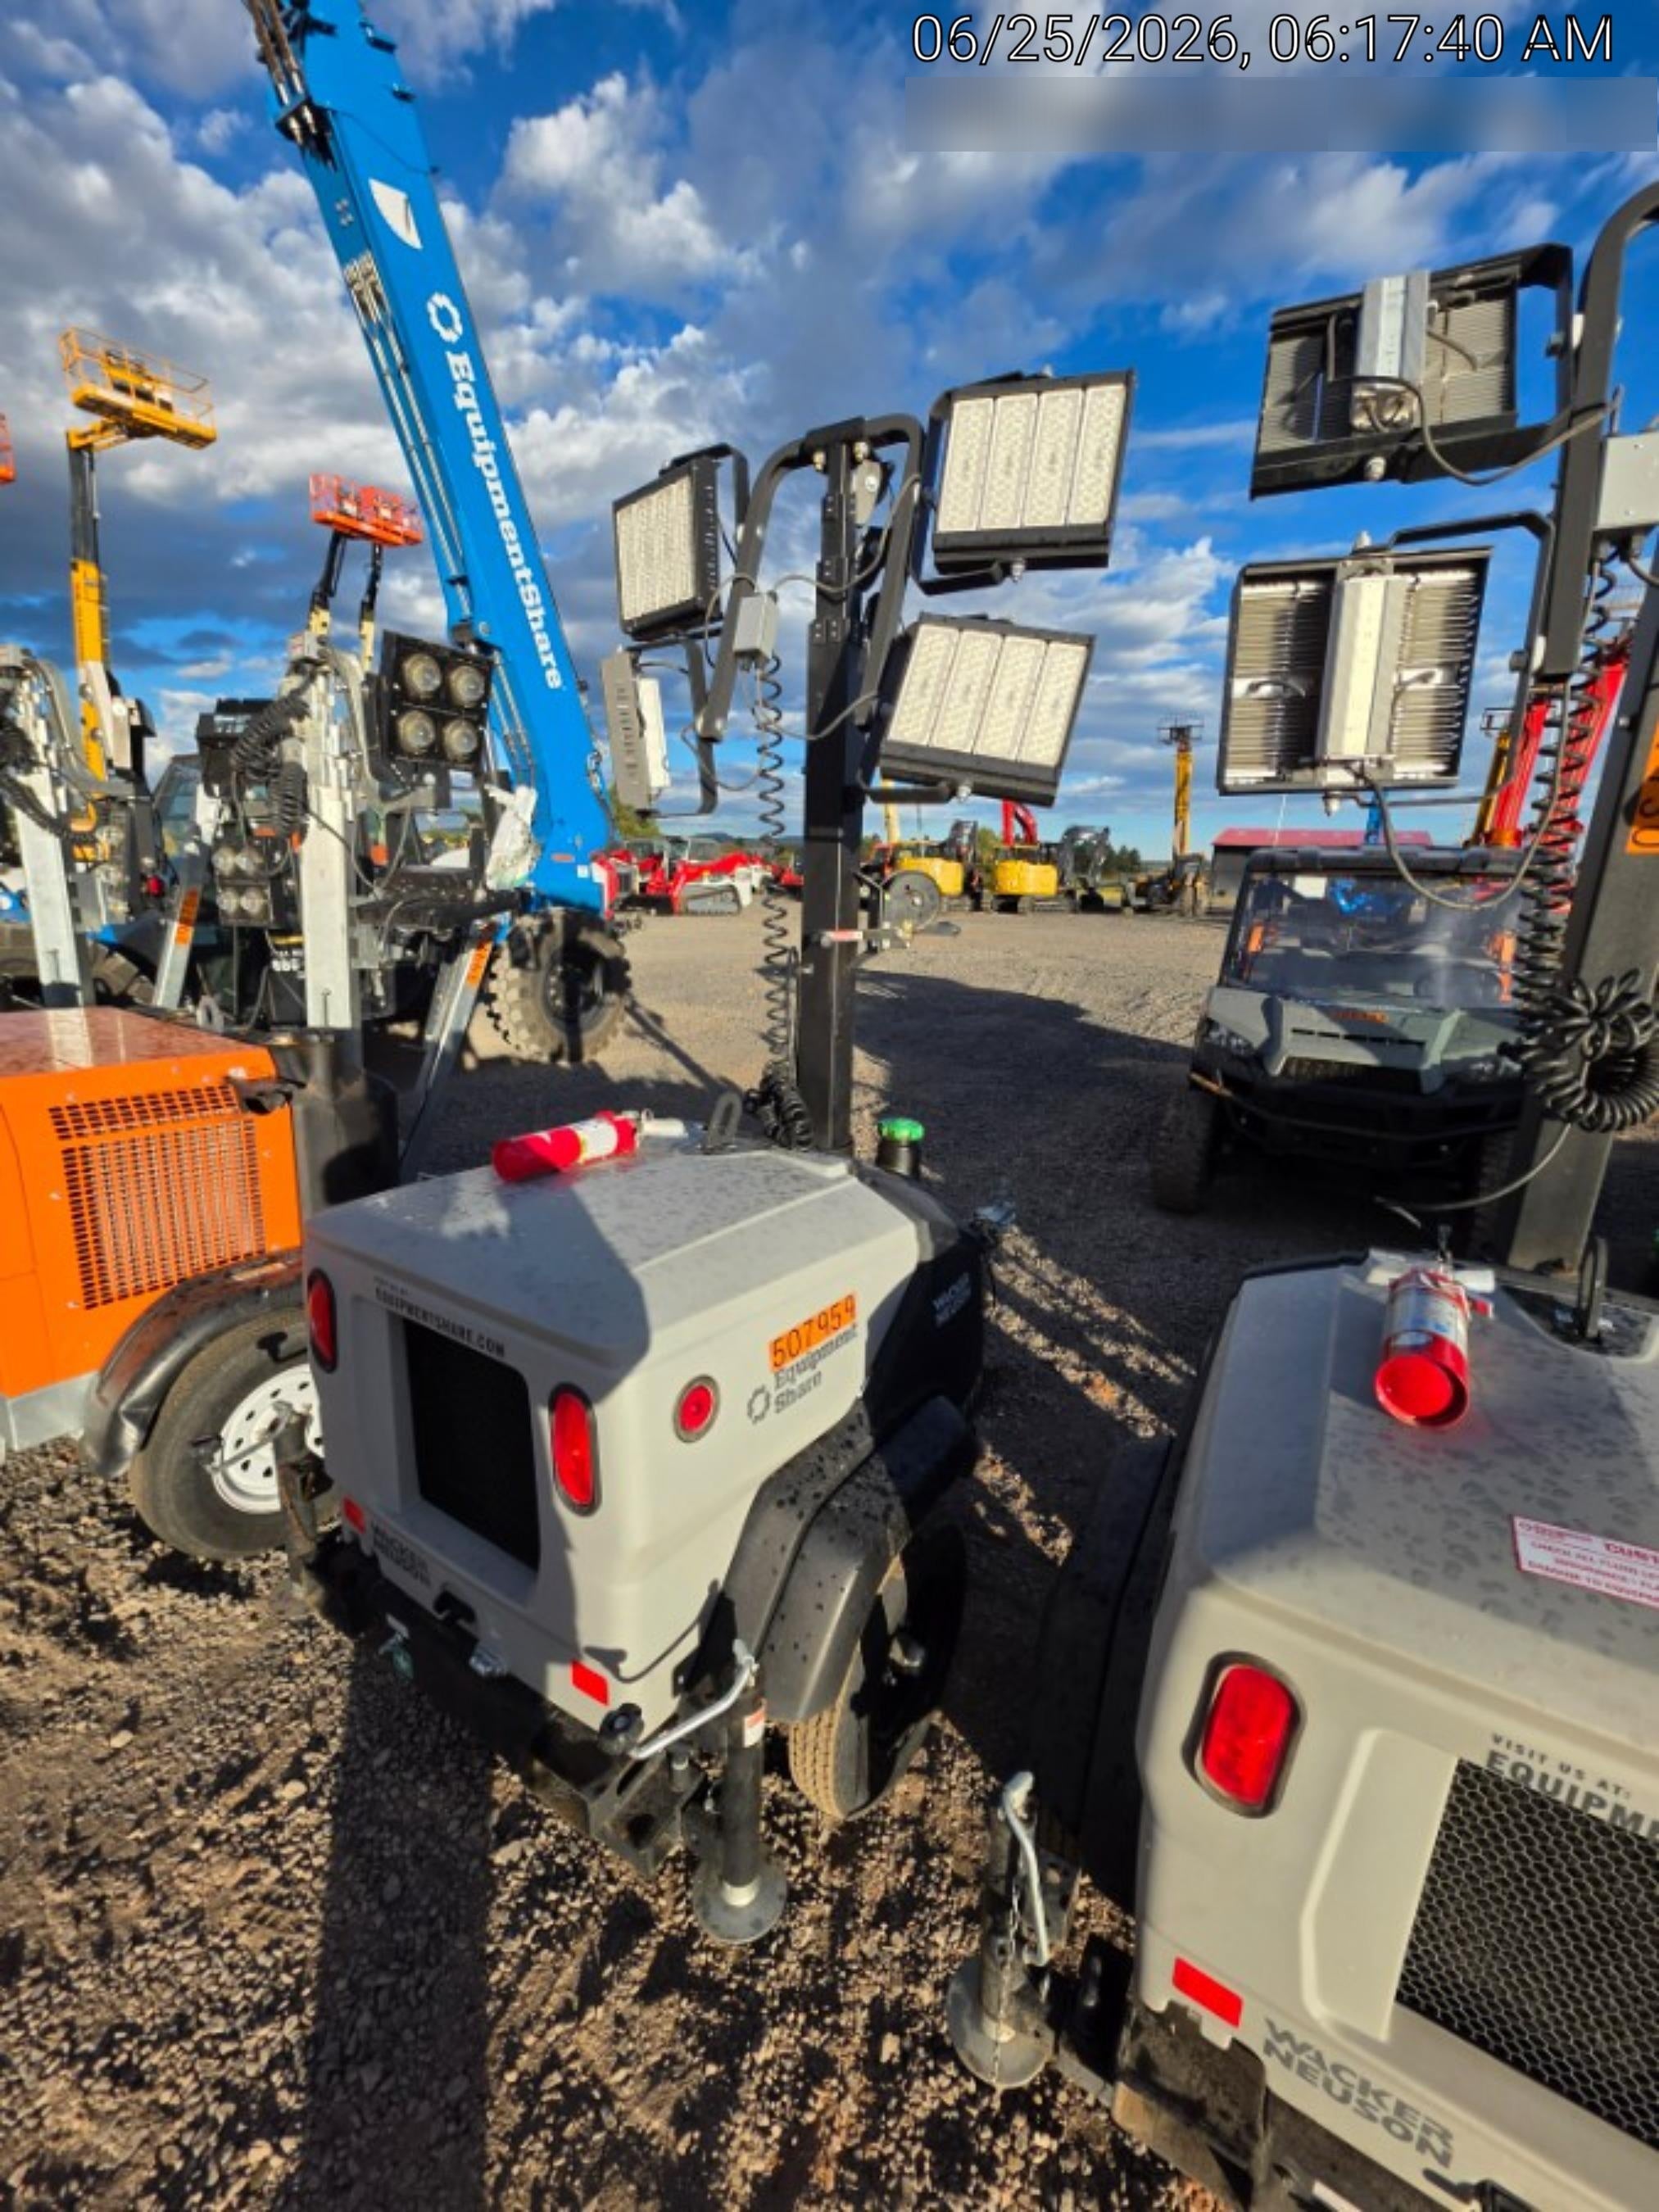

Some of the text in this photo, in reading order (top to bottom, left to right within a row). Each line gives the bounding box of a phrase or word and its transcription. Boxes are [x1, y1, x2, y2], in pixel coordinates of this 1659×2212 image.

[446, 350, 563, 690] EquipmentShare
[1492, 1733, 1548, 1765] VISIT
[1559, 1761, 1586, 1780] US
[1262, 2037, 1454, 2169] NEUSON
[1264, 2016, 1454, 2152] WACKER
